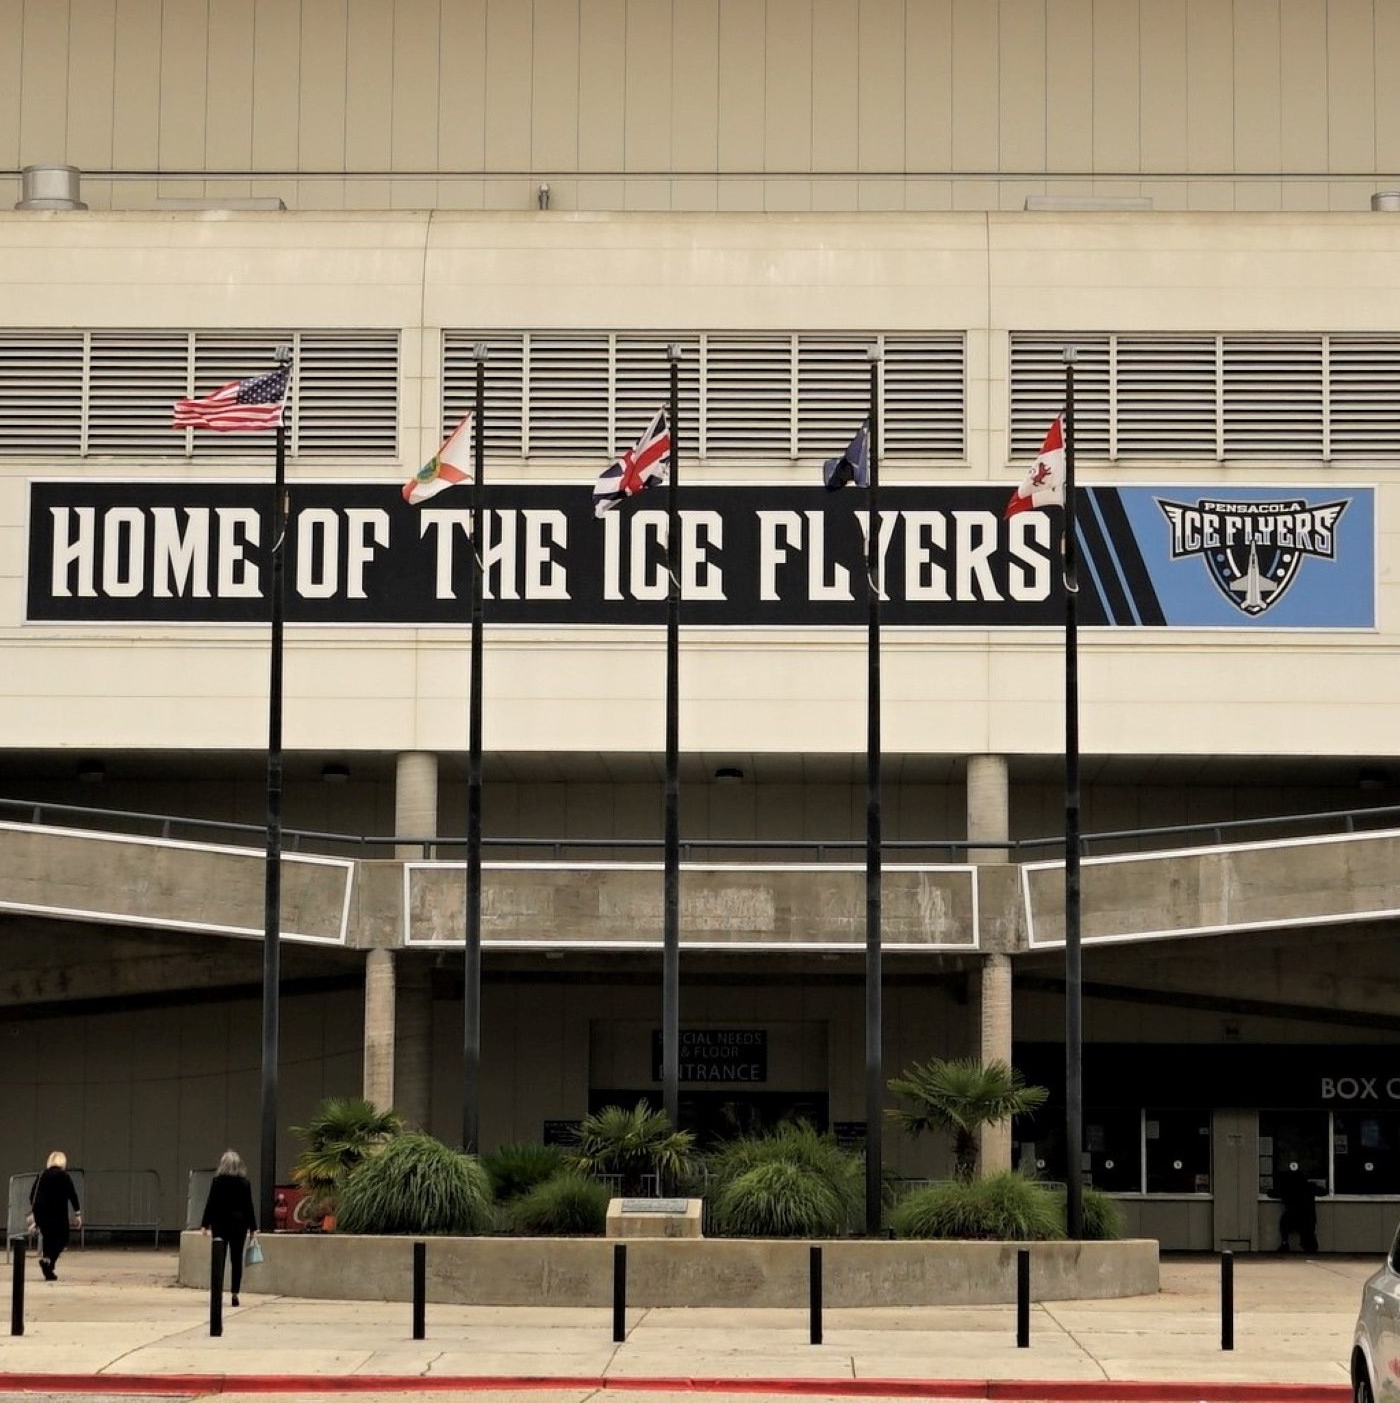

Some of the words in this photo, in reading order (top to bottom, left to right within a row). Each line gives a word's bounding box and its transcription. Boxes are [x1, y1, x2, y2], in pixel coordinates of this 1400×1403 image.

[1204, 502, 1302, 514] PENSACOLA
[1166, 506, 1221, 553] ICE
[1225, 507, 1340, 555] FLYERS
[49, 507, 264, 598] HOME
[296, 508, 390, 599] OF
[420, 509, 572, 600] THE
[602, 510, 728, 601] ICE
[755, 510, 1052, 601] FLYERS
[658, 1032, 712, 1045] SECIAL
[718, 1032, 762, 1045] NEEDS
[658, 1063, 761, 1080] TRANCE
[1322, 1077, 1378, 1099] BOX
